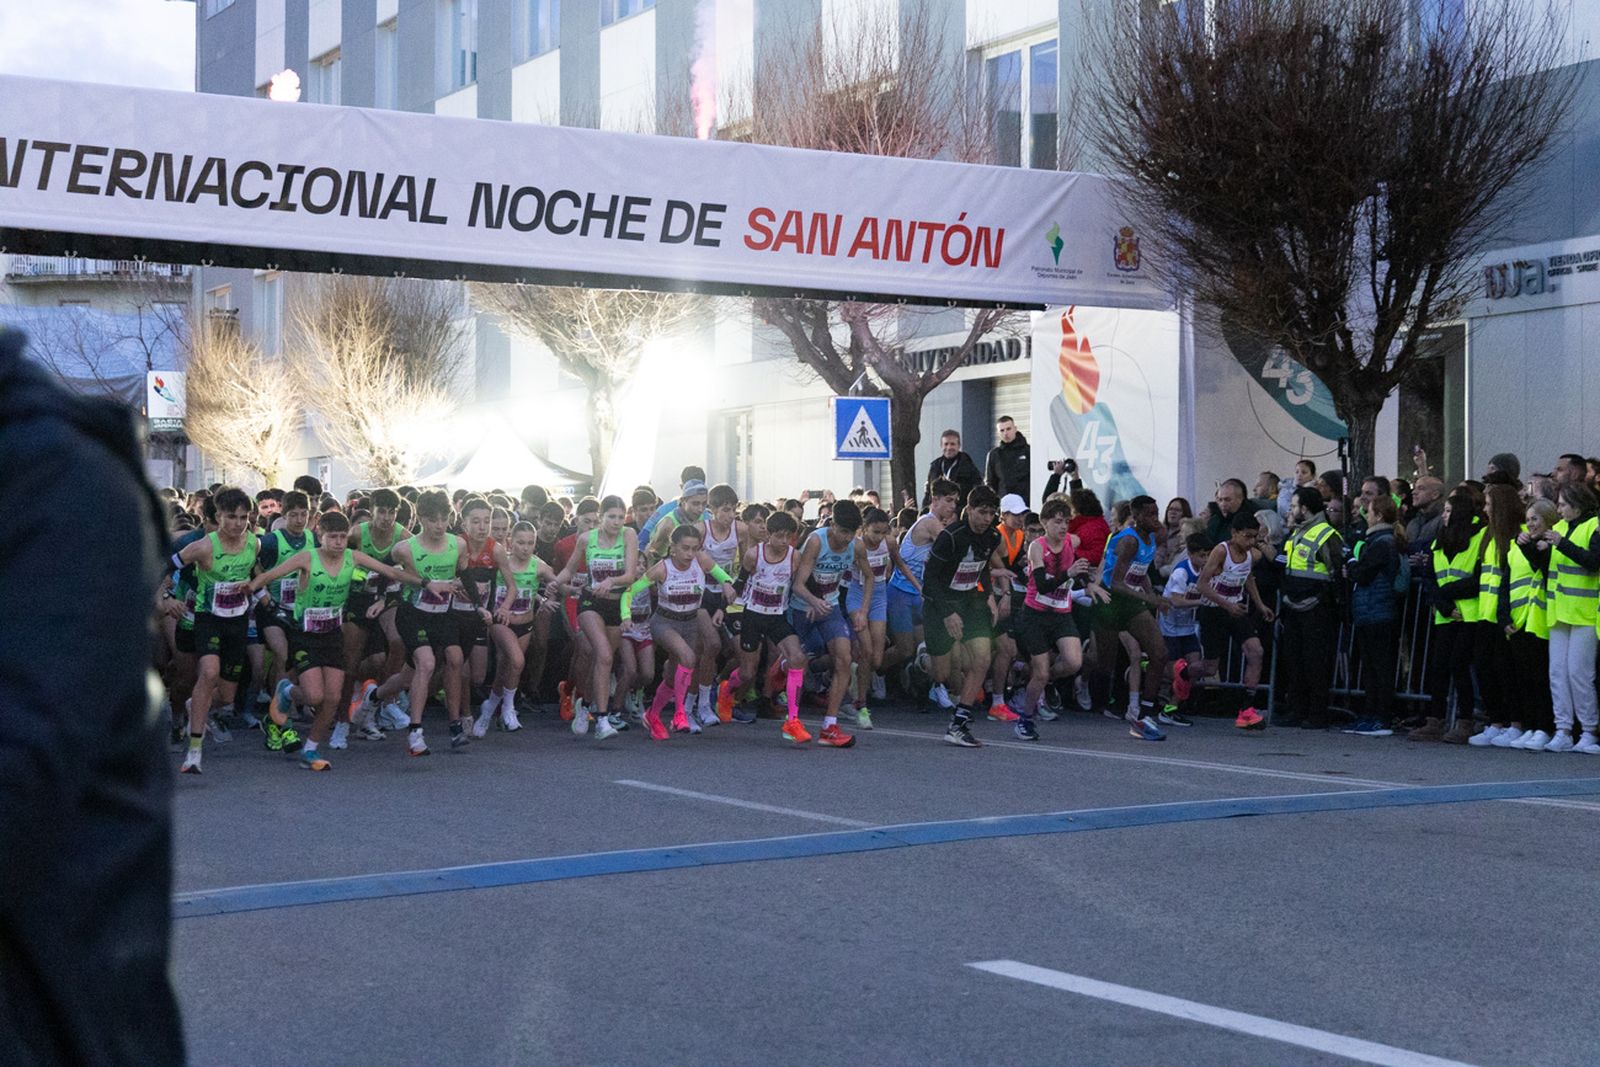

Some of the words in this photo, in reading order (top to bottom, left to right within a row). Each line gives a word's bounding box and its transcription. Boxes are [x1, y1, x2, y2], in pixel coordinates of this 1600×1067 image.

[467, 182, 652, 242] NOCHE
[659, 199, 728, 248] DE
[743, 207, 843, 257] SAN
[847, 212, 1005, 269] ANTÓN
[896, 337, 1021, 371] NIVEIDAD
[1262, 343, 1314, 406] 43
[1076, 420, 1118, 485] 43
